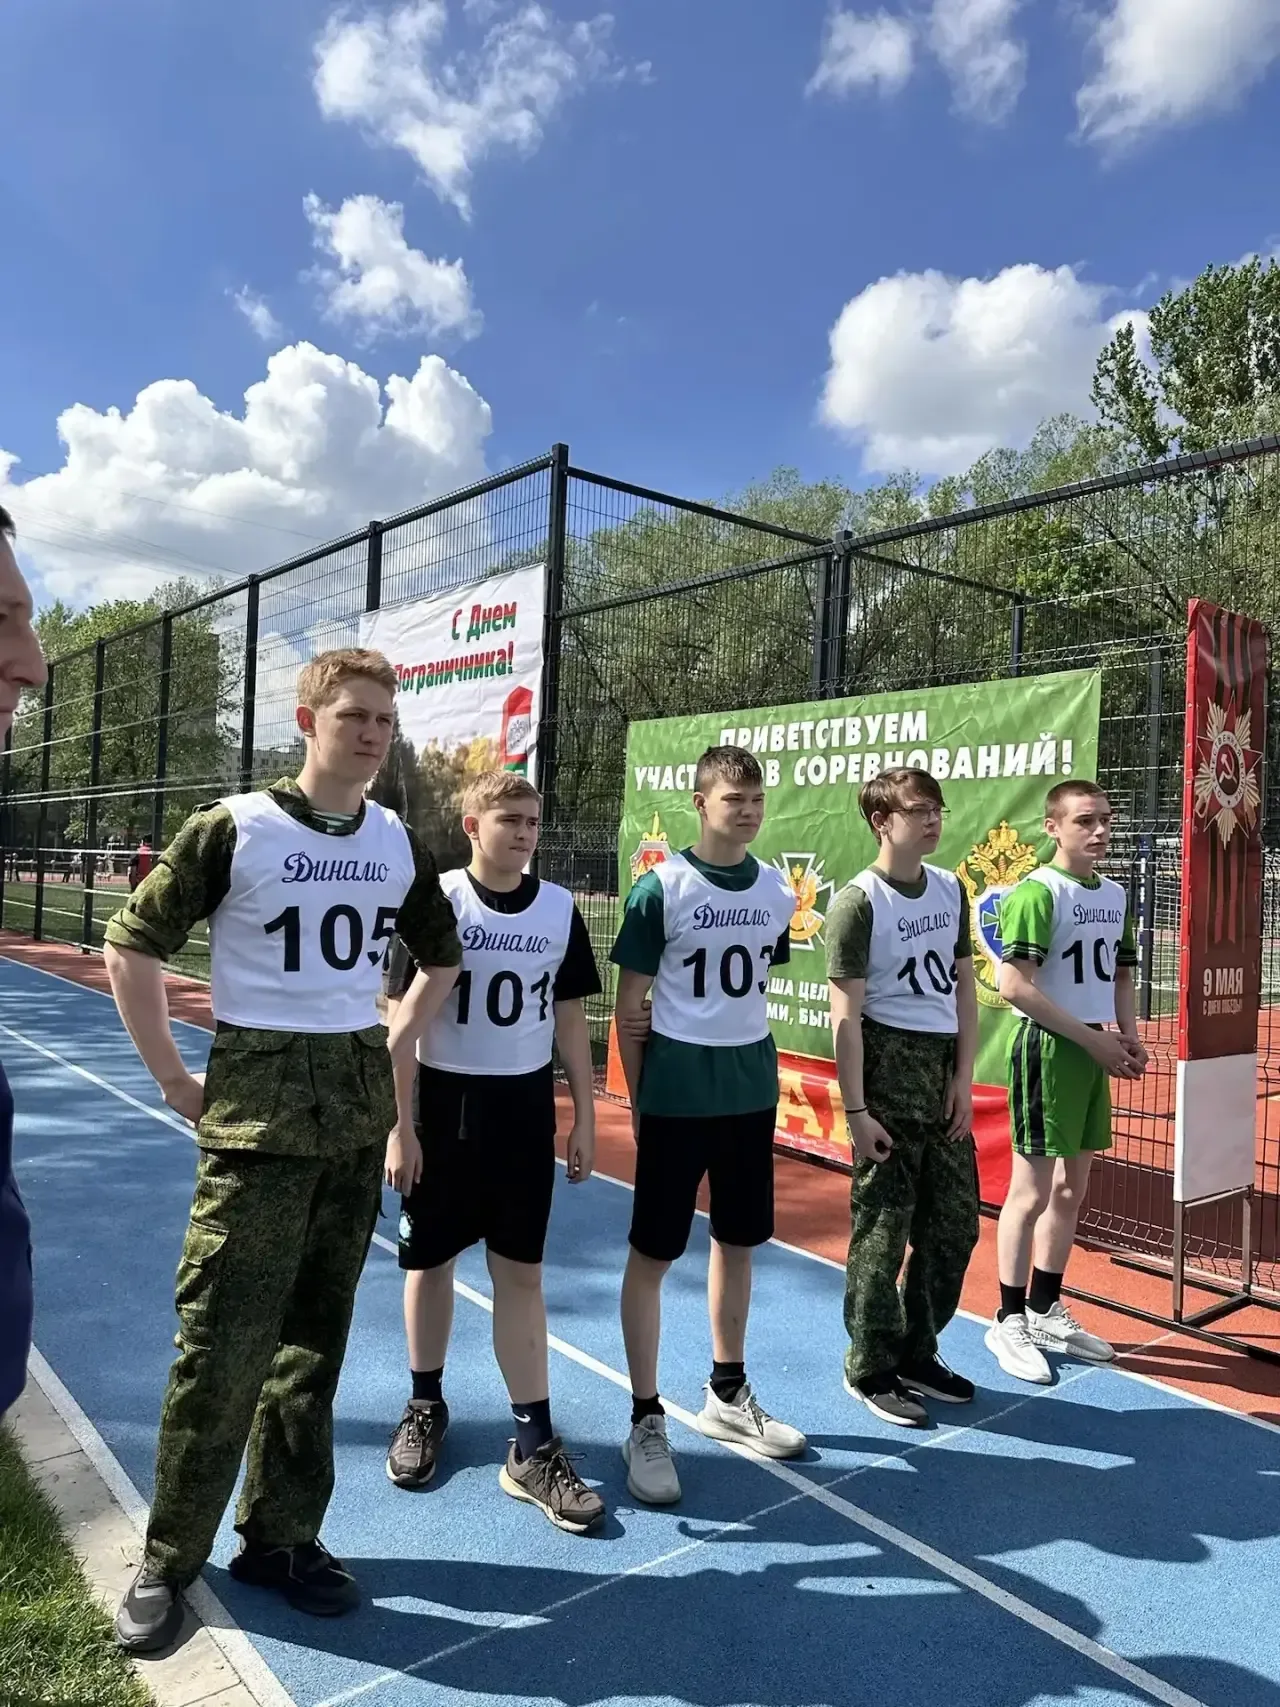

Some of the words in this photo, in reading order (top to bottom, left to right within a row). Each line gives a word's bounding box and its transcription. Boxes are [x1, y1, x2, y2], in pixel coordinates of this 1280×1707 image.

[451, 608, 463, 640] С
[466, 601, 517, 643] Днем
[394, 641, 513, 694] Пограничника!
[719, 709, 927, 753] ПРИВЕТСТВУЕМ
[634, 758, 780, 791] УЧАСТВ
[793, 731, 1073, 786] СОРЕВНОВАНИЙ!
[281, 851, 390, 883] Динамо
[692, 902, 771, 931] Динамо
[1073, 903, 1122, 926] Динамо
[462, 924, 552, 954] Динамо
[1061, 937, 1121, 985] 10
[1203, 968, 1212, 996] 9
[1215, 967, 1243, 995] МАЯ
